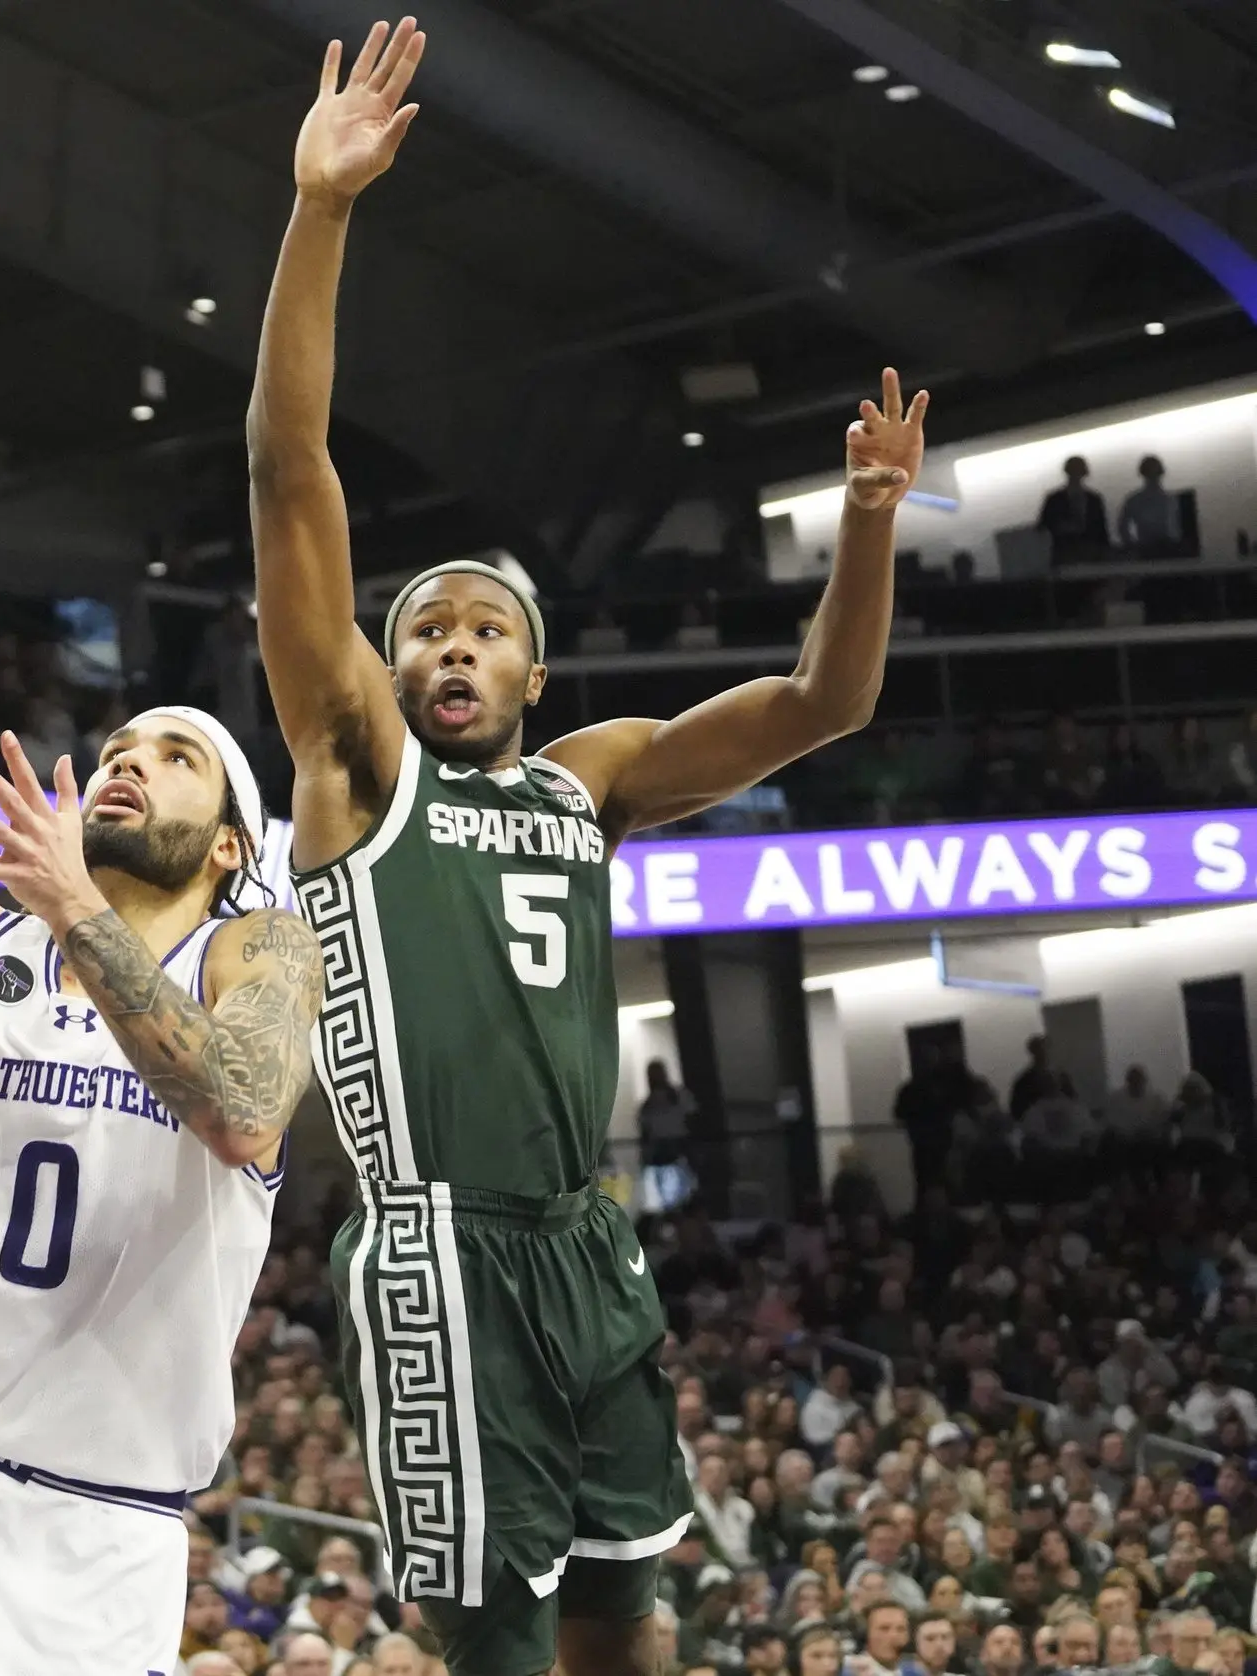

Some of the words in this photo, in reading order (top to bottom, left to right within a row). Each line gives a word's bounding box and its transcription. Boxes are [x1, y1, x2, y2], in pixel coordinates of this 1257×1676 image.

[743, 827, 1152, 920] ALWAYS
[1192, 822, 1257, 894] S
[500, 872, 570, 989] 5
